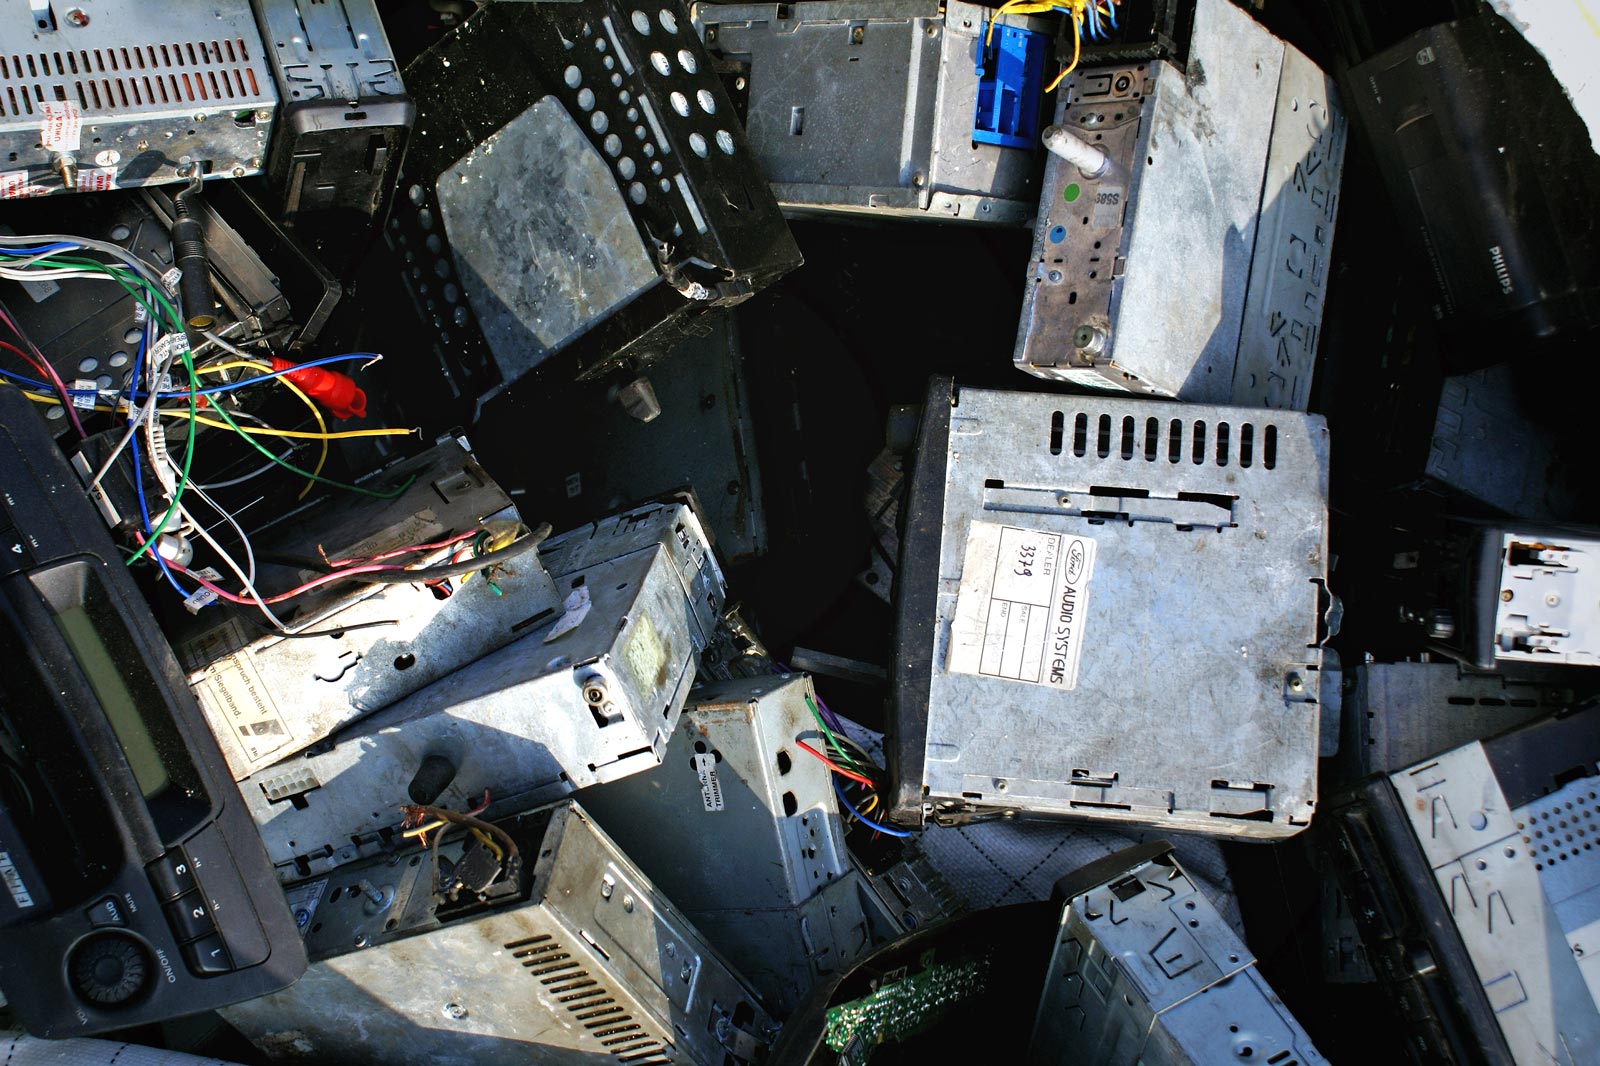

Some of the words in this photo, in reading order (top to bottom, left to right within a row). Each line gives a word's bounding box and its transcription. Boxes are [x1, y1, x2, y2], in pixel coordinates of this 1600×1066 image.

[1489, 245, 1513, 294] PHILIPS
[12, 544, 23, 554] 4
[1043, 537, 1055, 575] DEALER
[1059, 585, 1076, 623] AUDIO
[1050, 627, 1070, 684] SYSTEMS
[213, 673, 241, 719] Siegelband.
[229, 652, 251, 685] nspruch
[247, 684, 268, 715] besteht
[709, 770, 721, 807] TRIMMER
[176, 864, 186, 875] 3
[106, 901, 120, 922] AUD
[125, 893, 137, 912] MUTE
[193, 906, 205, 918] 2
[156, 947, 176, 983] ON/OFF
[211, 948, 221, 957] 1
[76, 1006, 88, 1025] VOL
